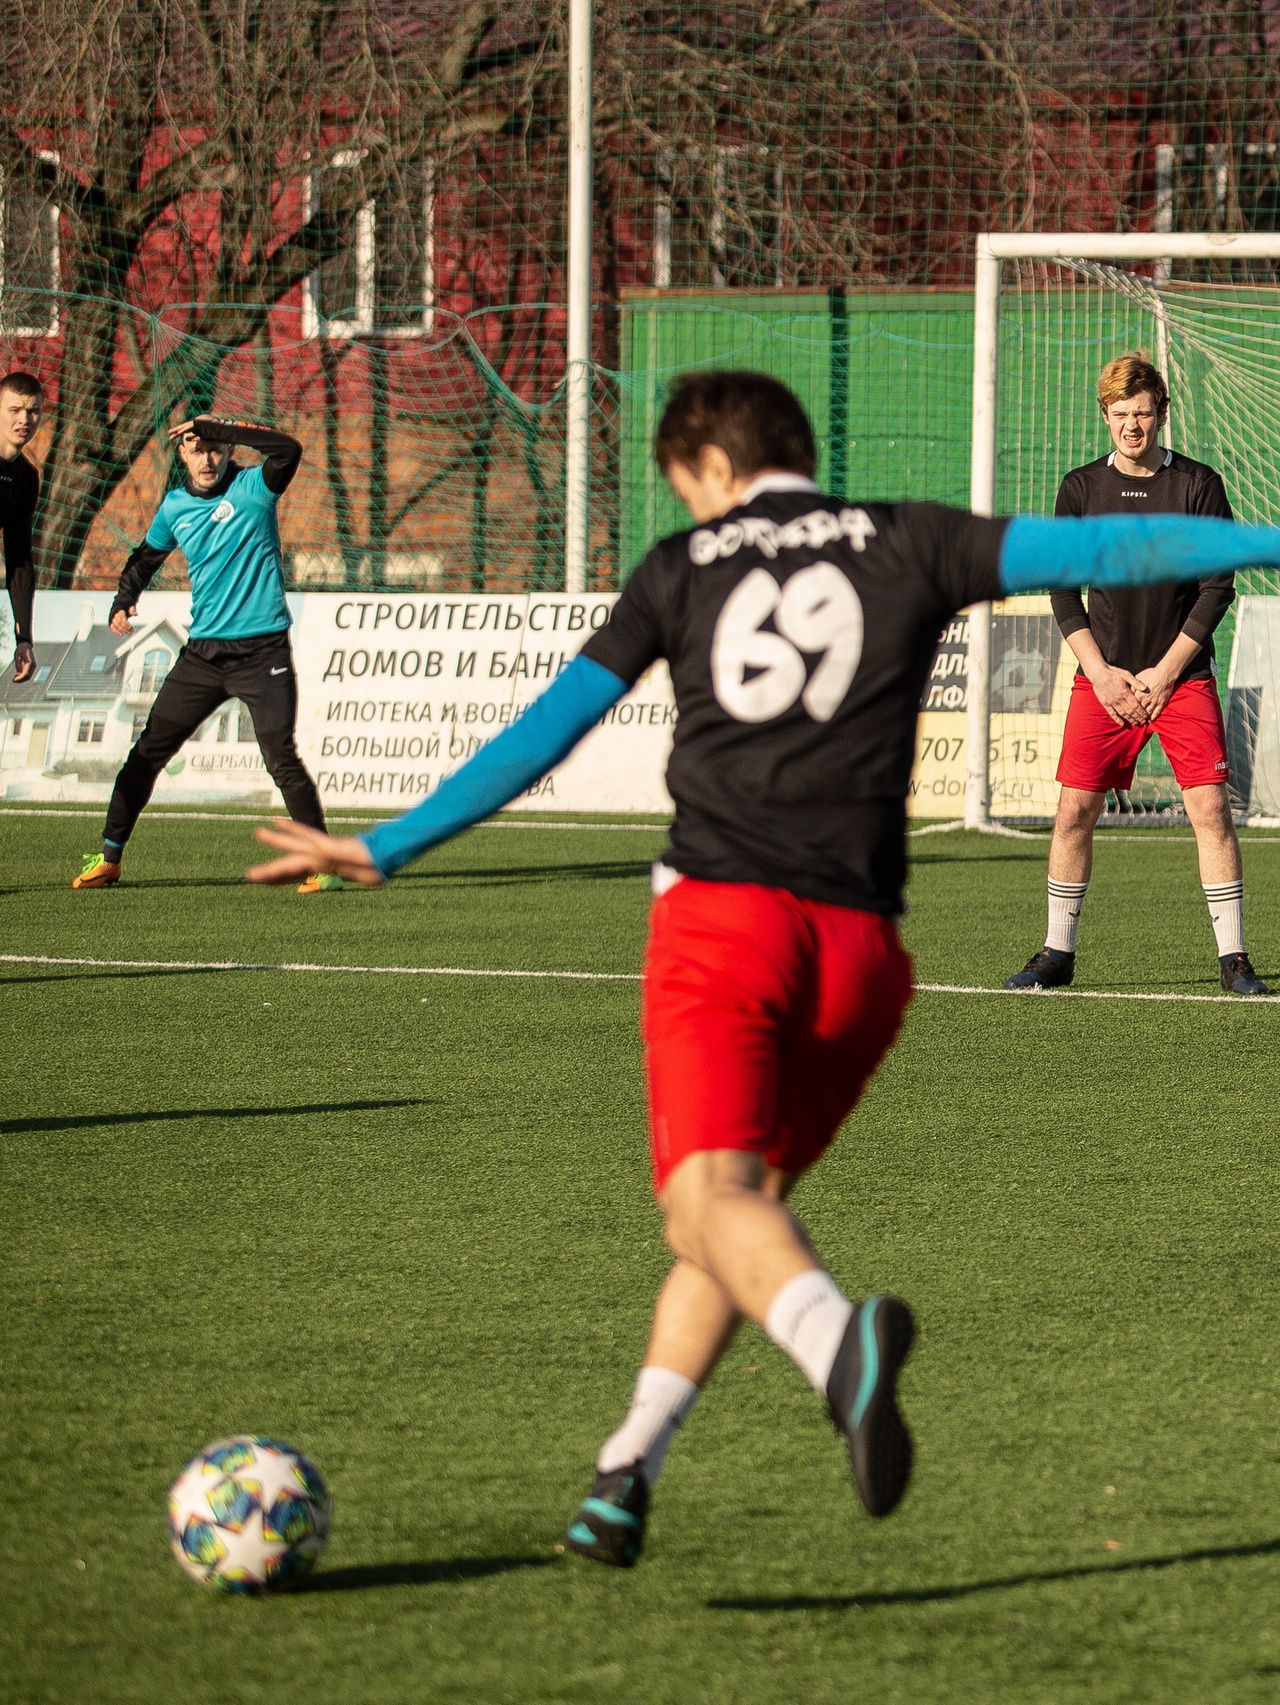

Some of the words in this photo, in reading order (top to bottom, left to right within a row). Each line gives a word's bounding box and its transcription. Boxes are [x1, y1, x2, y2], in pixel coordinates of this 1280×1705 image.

[335, 602, 610, 631] СТРОИТЕЛЬСТВО
[710, 562, 865, 723] 69
[323, 649, 443, 682] ДОМОВ
[455, 651, 477, 678] И
[326, 701, 432, 723] ИПОТЕКА
[440, 701, 456, 723] И
[321, 731, 440, 758] БОЛЬШОЙ
[921, 737, 965, 761] 707
[1012, 739, 1038, 764] 15
[316, 771, 429, 794] ГАРАНТИЯ
